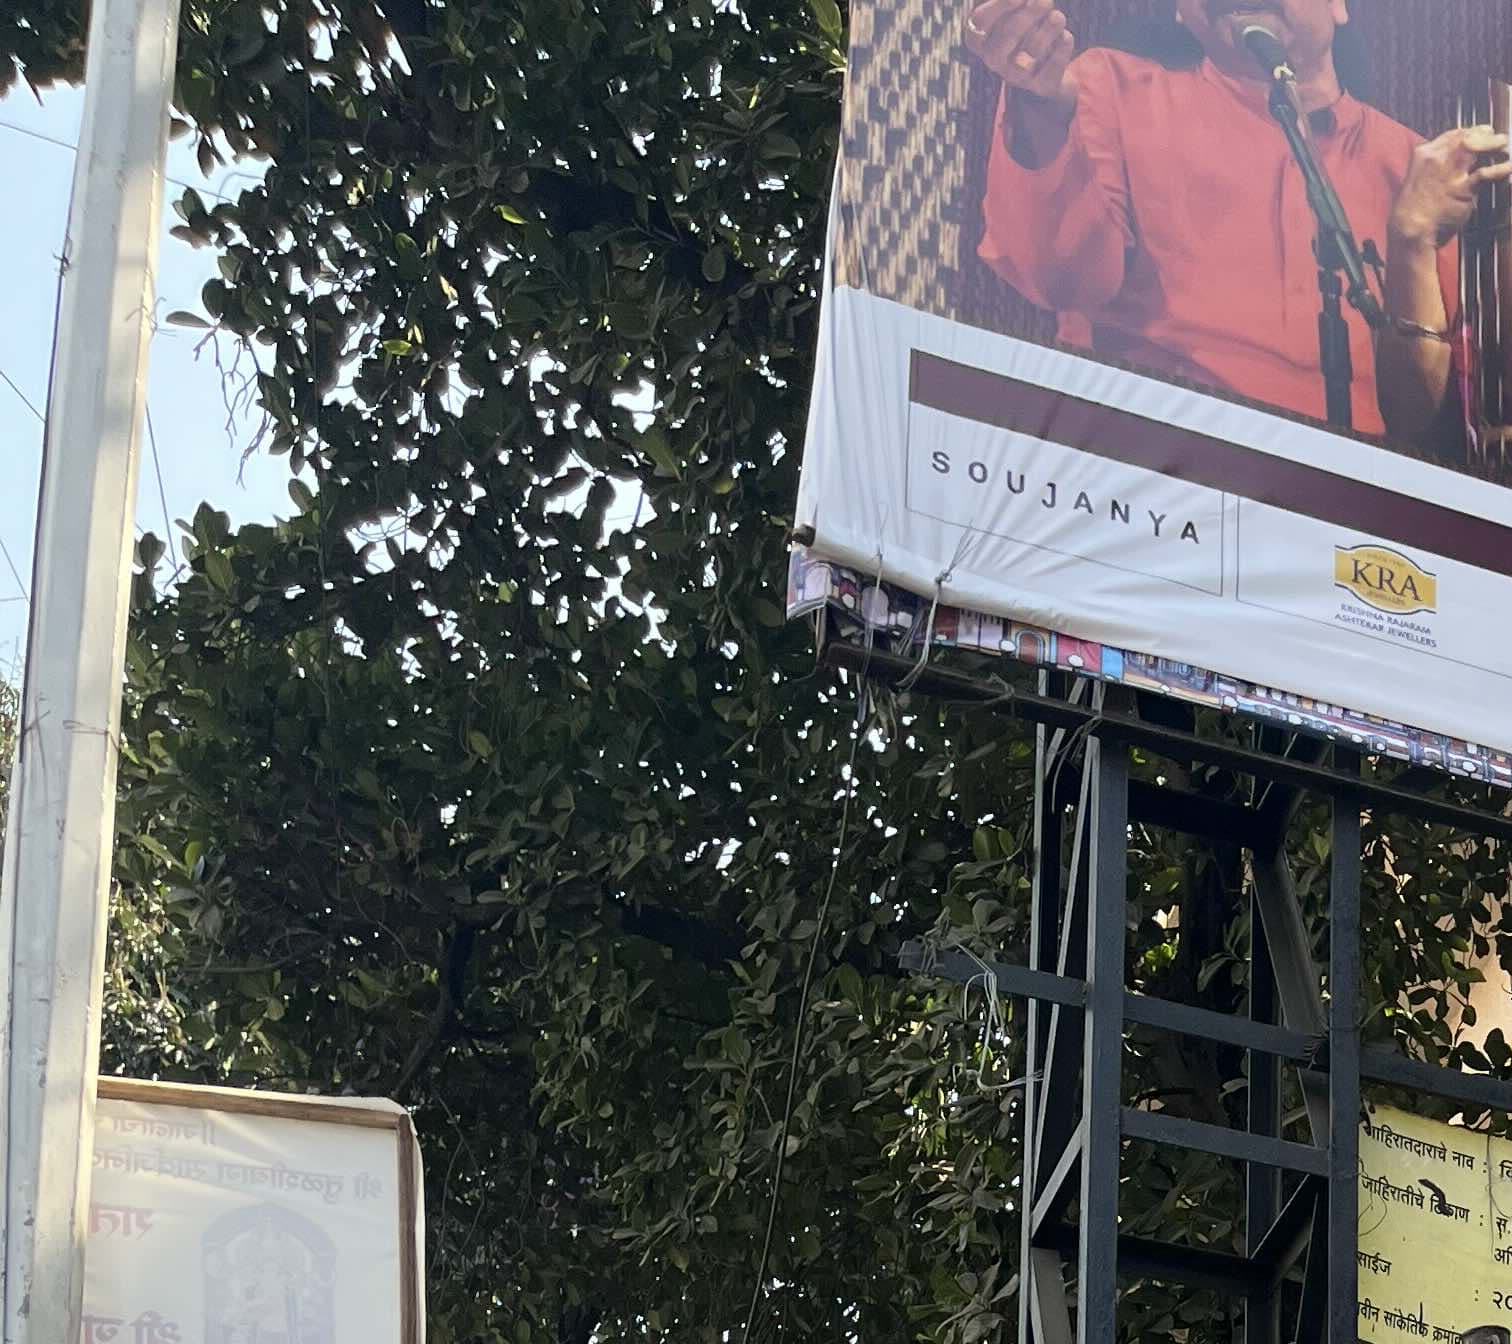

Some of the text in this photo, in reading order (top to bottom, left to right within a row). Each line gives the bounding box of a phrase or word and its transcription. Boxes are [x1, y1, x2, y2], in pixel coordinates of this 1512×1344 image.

[931, 449, 1201, 545] SOUJANYA
[1351, 558, 1424, 602] KRA
[1387, 624, 1438, 648] JEWELLERS
[1452, 1151, 1475, 1170] नाव
[1360, 1175, 1425, 1210] जाहिरातीचे
[1357, 1297, 1380, 1323] वीन
